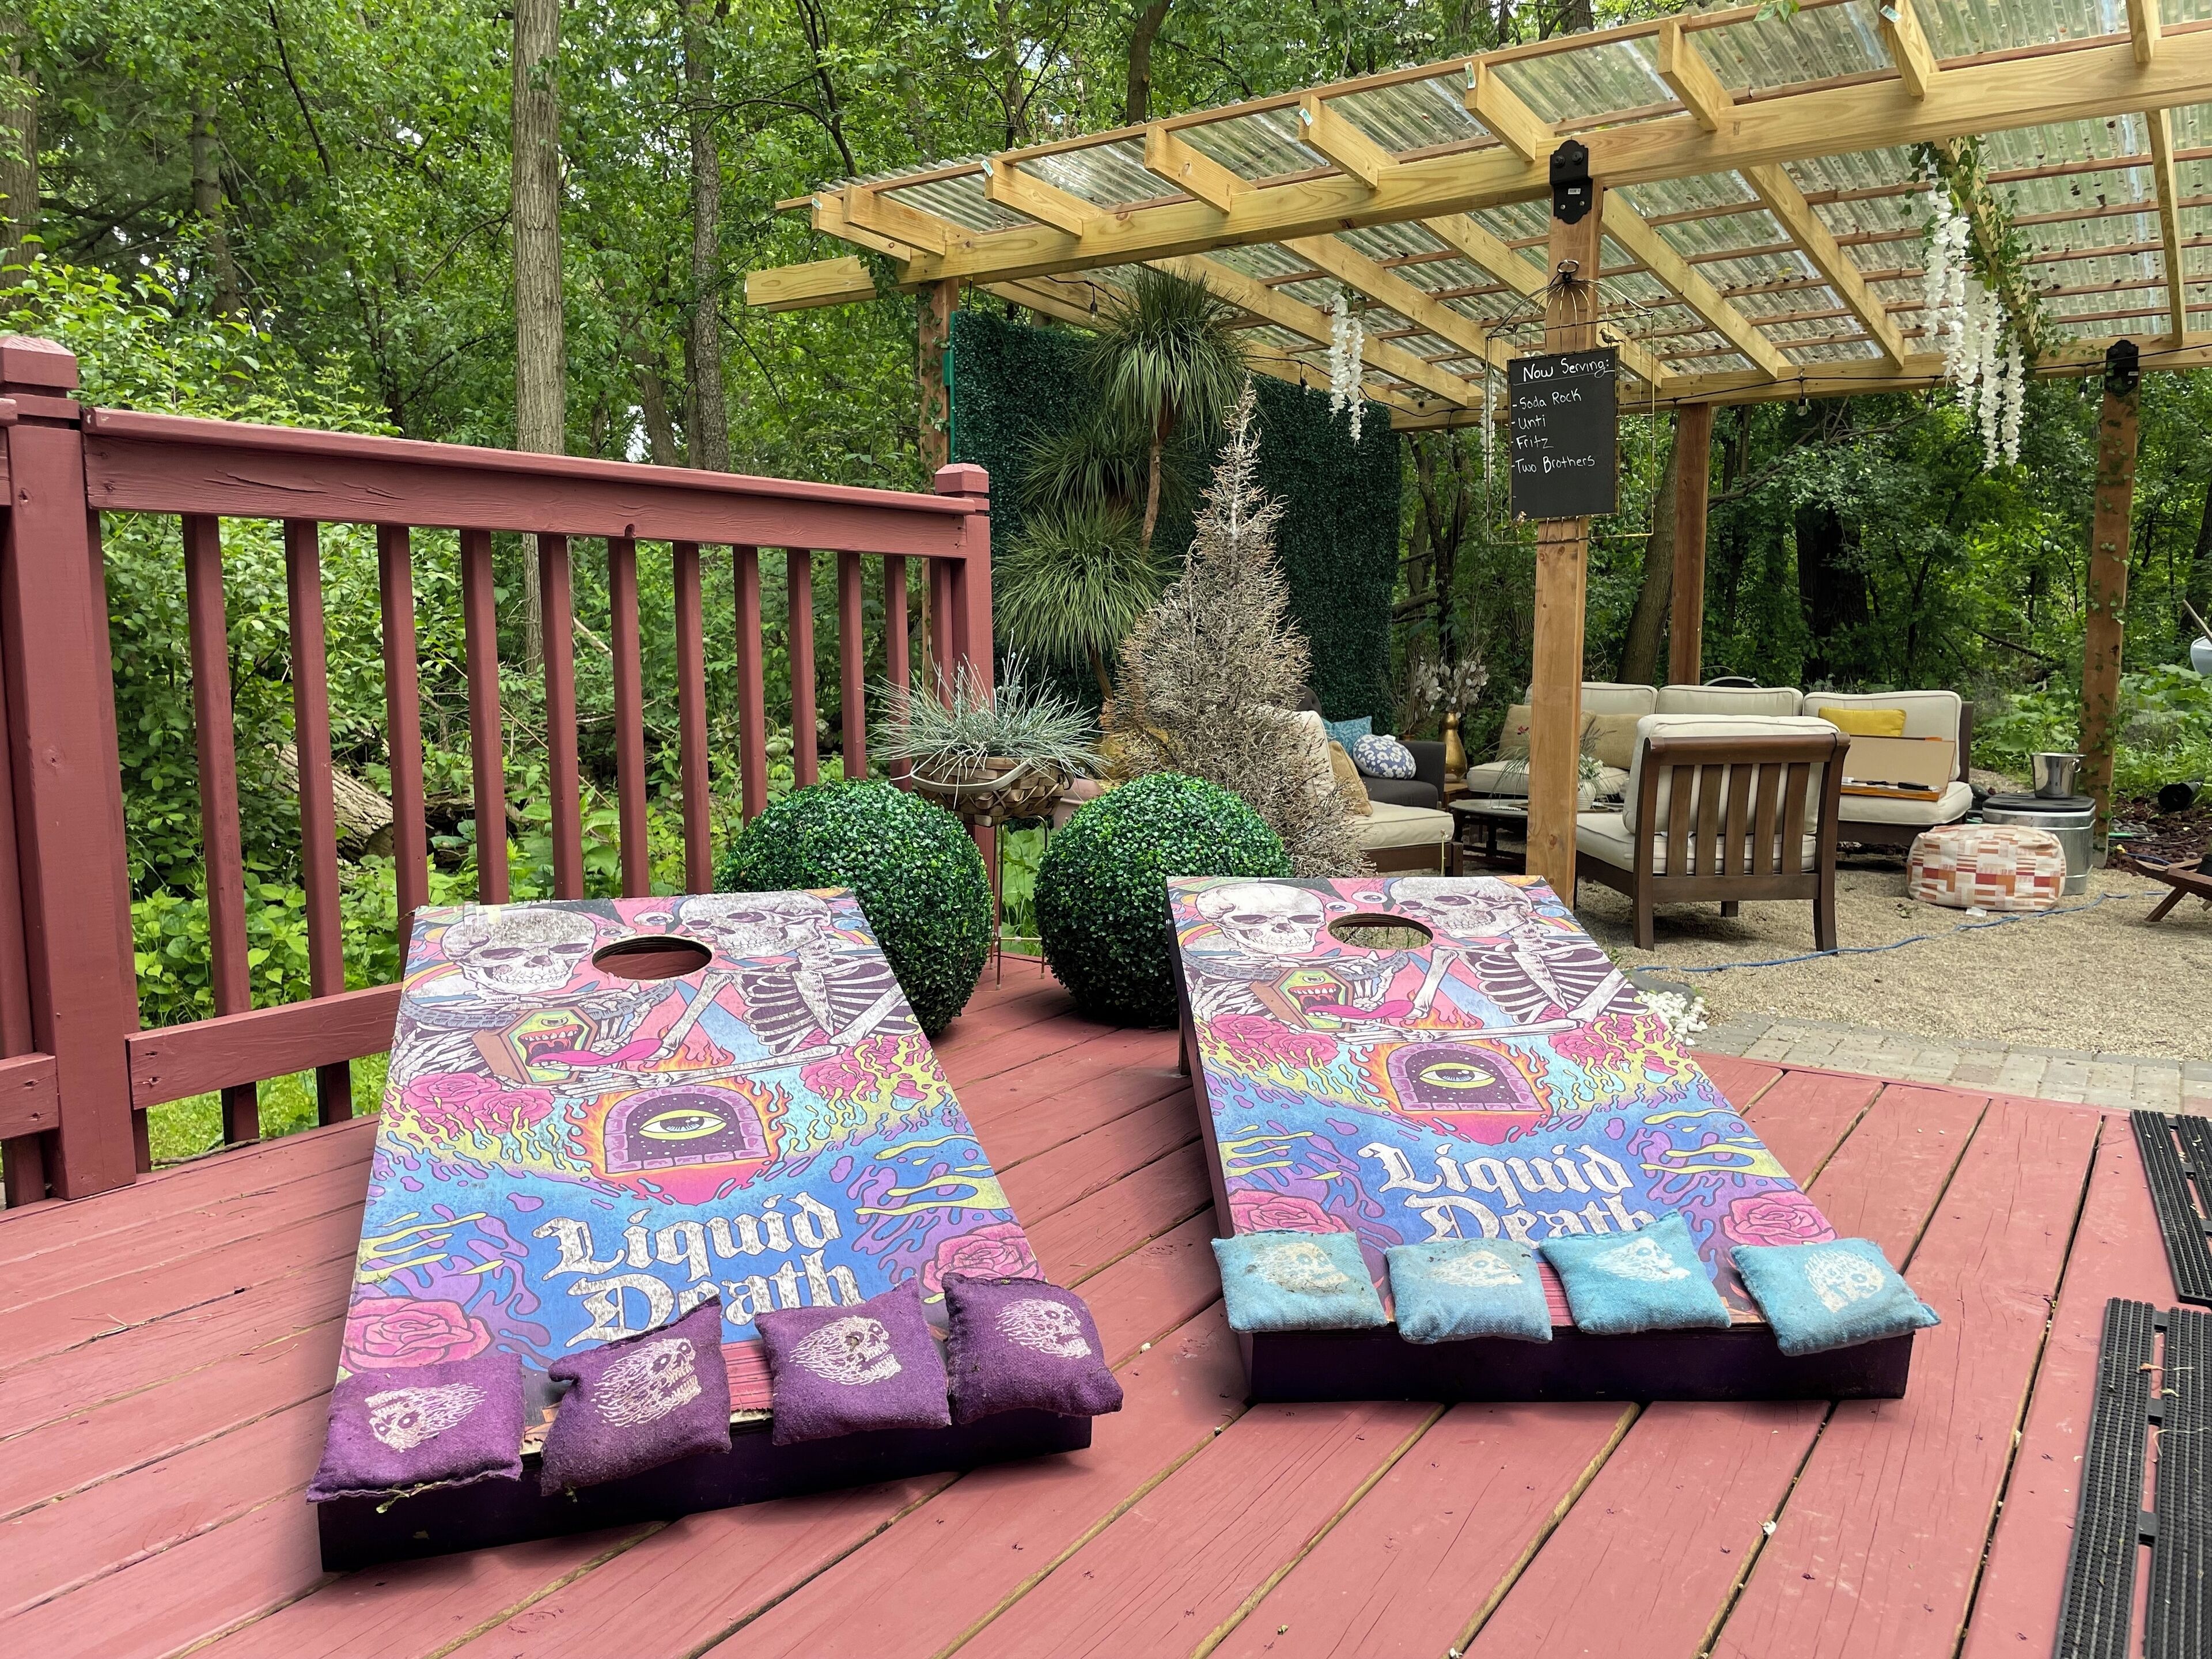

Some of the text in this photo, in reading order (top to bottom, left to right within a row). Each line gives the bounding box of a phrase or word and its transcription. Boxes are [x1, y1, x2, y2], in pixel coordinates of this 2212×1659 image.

[1523, 358, 1610, 382] Now Serving:
[1543, 454, 1595, 474] Brothers
[1357, 1141, 1635, 1209] Liquid
[532, 1192, 842, 1282] Liquid
[1403, 1194, 1657, 1250] Death
